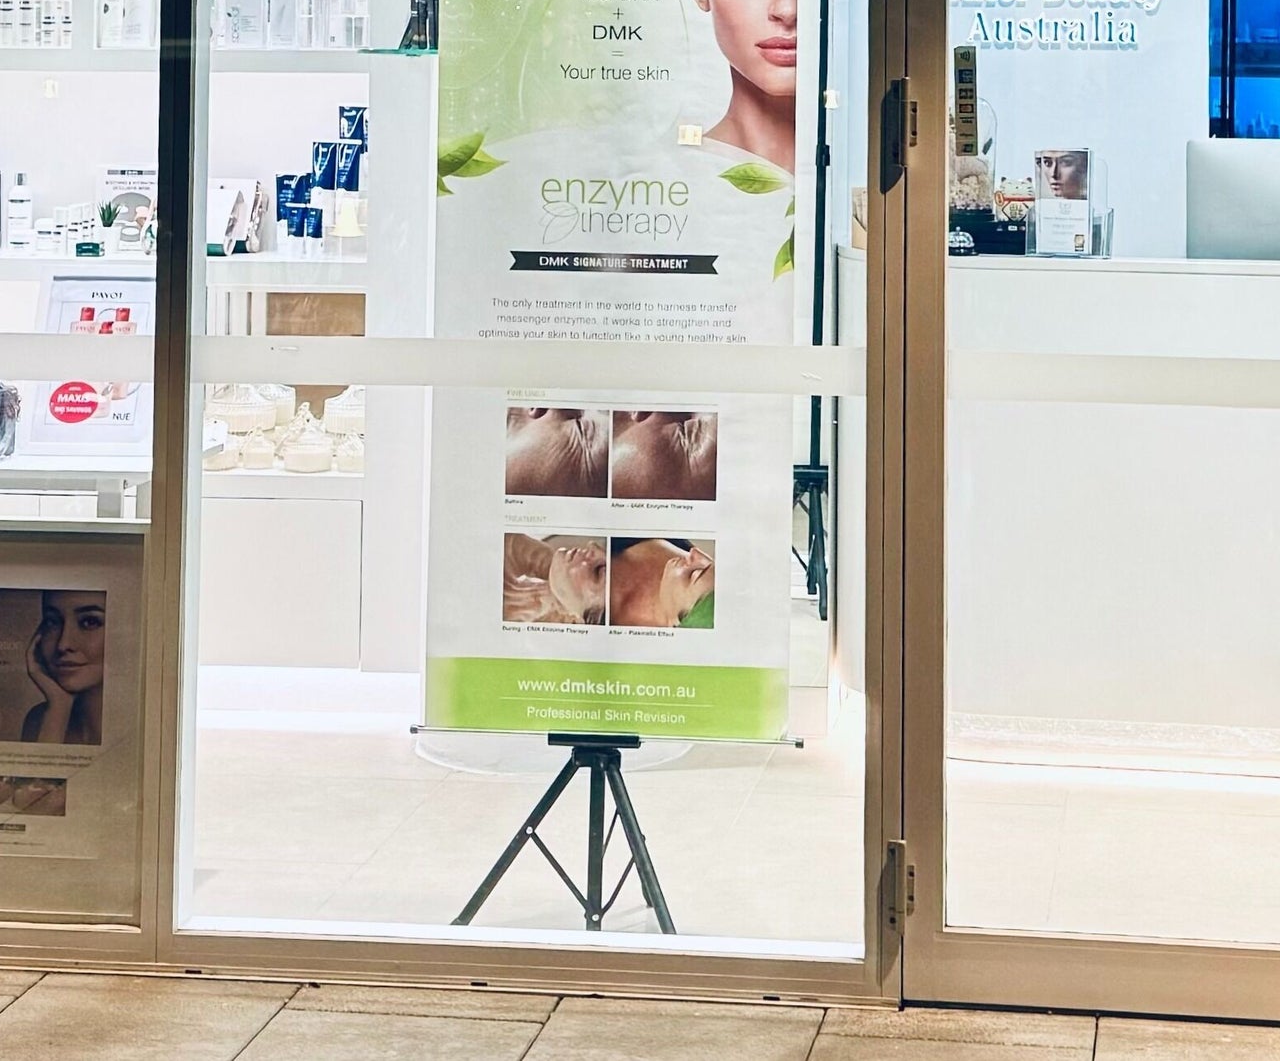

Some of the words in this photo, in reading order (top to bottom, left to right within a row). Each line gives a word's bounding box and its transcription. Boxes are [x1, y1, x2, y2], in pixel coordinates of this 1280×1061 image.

[612, 7, 624, 20] +
[592, 24, 643, 41] DMK
[967, 10, 1137, 43] Australia
[560, 64, 596, 80] Your
[601, 65, 632, 81] true
[540, 178, 690, 212] enzyme
[580, 207, 689, 241] therapy
[539, 256, 570, 267] DMK
[573, 257, 627, 268] SIGNATURE
[629, 258, 689, 270] TREATMENT
[91, 291, 123, 299] PAYOT
[492, 298, 509, 308] The
[512, 298, 532, 310] only
[535, 299, 581, 309] treatment
[584, 299, 593, 309] in
[596, 300, 611, 310] the
[614, 302, 641, 311] world
[644, 302, 654, 311] to
[657, 303, 697, 312] harness
[700, 303, 737, 312] transfer
[497, 315, 551, 326] messenger
[611, 317, 640, 326] works
[643, 318, 653, 327] to
[656, 318, 710, 329] strengthen
[712, 319, 732, 328] and
[523, 330, 544, 340] your
[548, 330, 567, 338] skin
[570, 331, 580, 340] to
[582, 331, 621, 341] function
[624, 332, 641, 341] like
[517, 678, 696, 698] www.dmkskin.com.au
[527, 706, 601, 721] Professional
[605, 709, 631, 722] Skin
[634, 710, 686, 724] Revision
